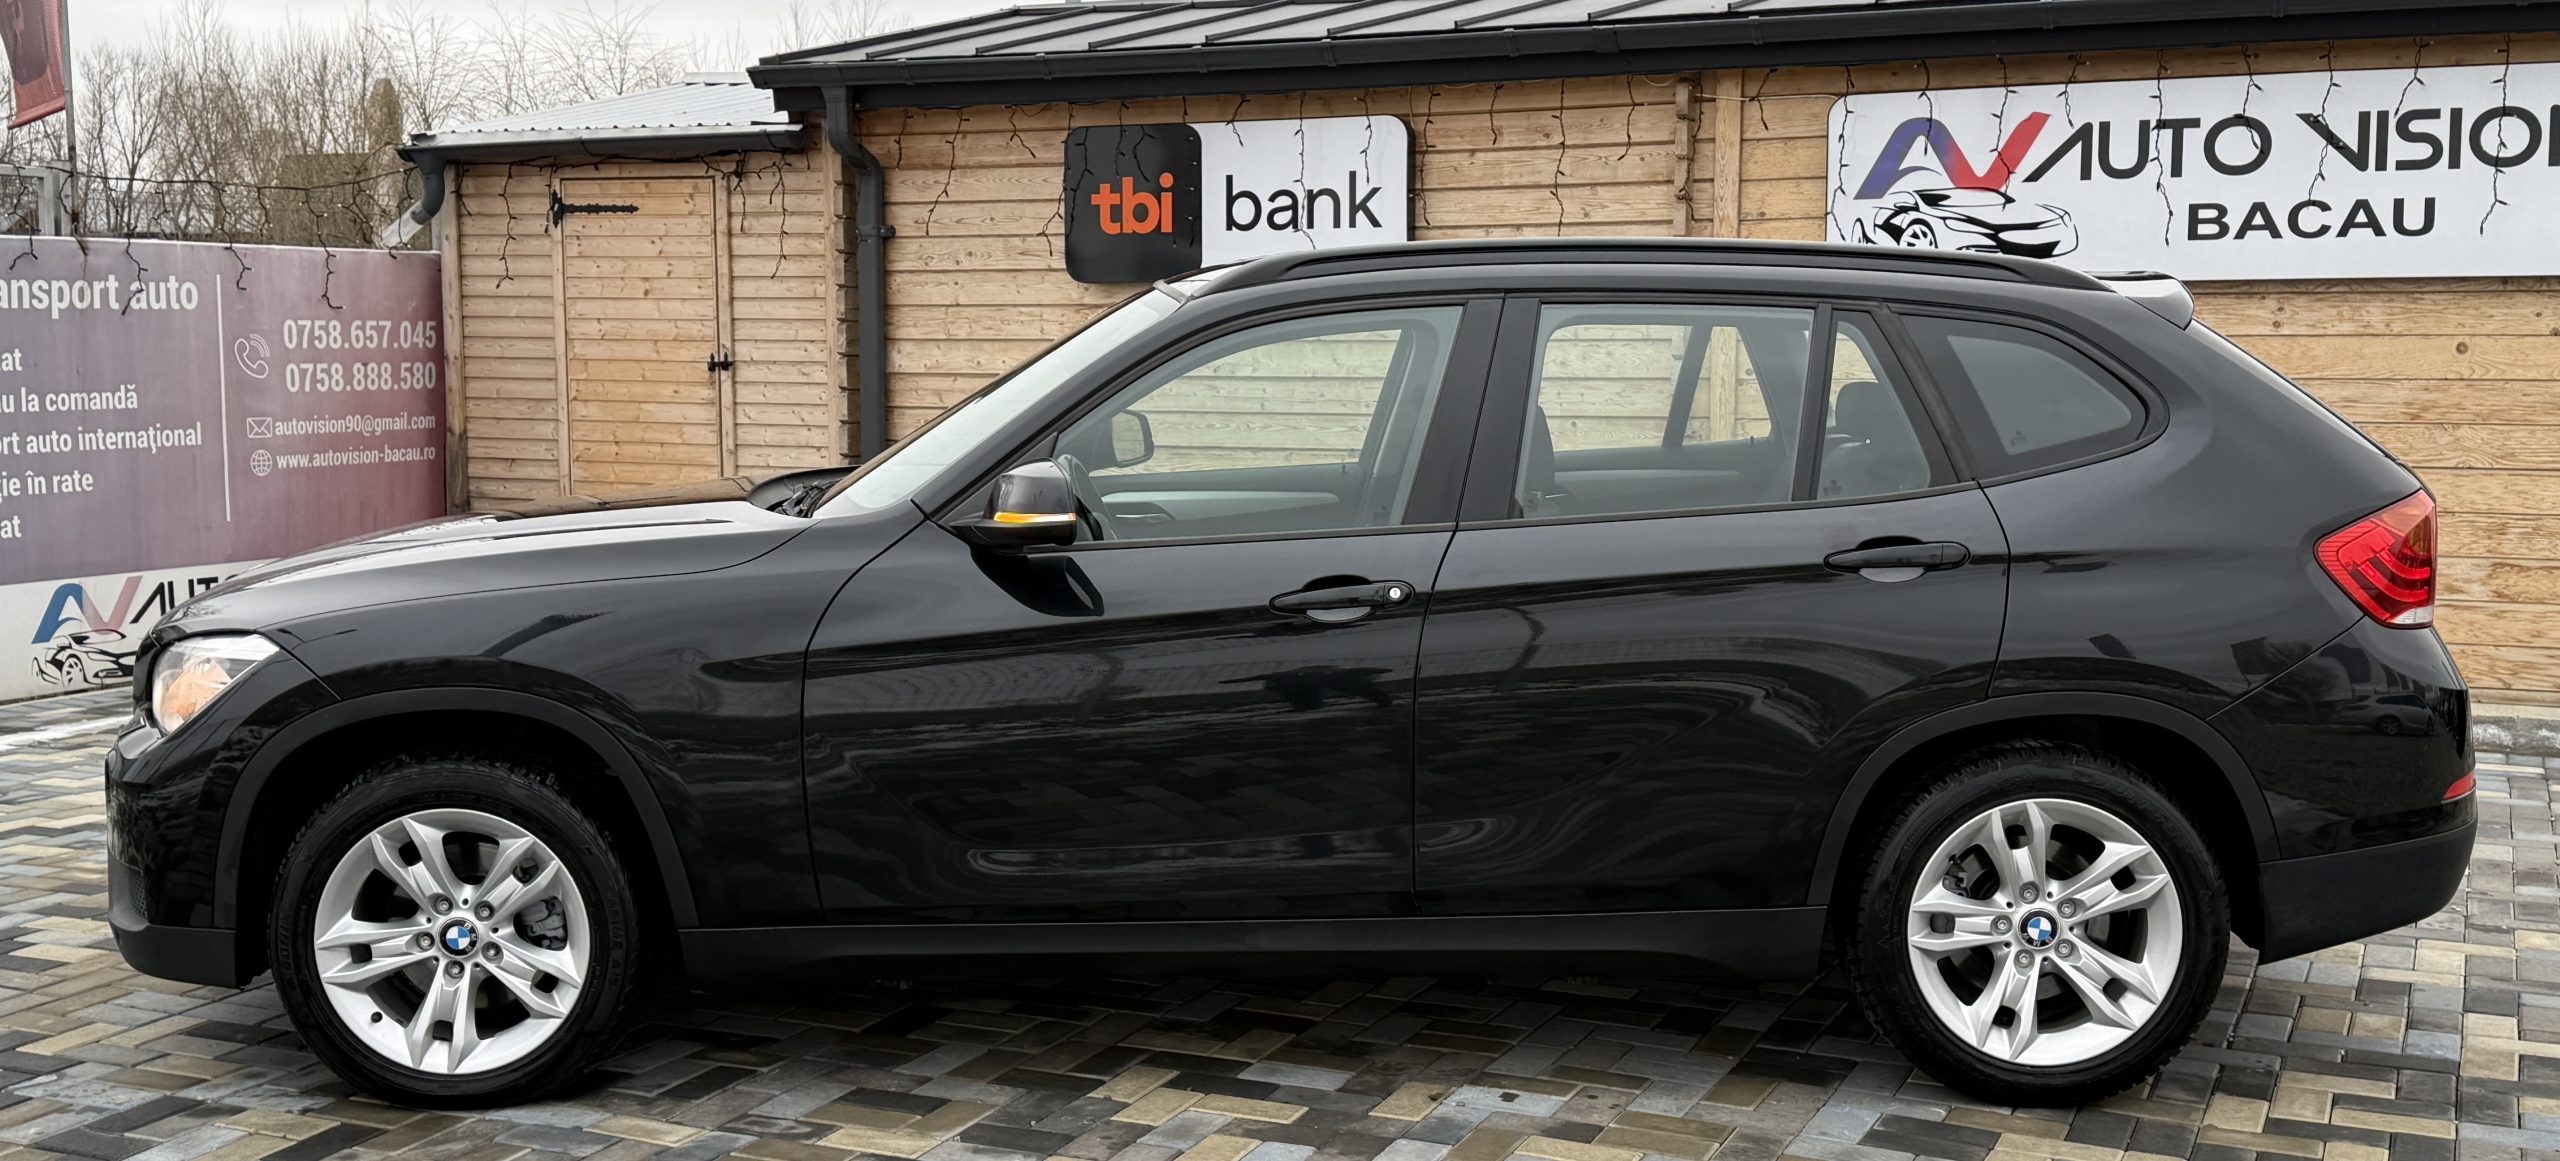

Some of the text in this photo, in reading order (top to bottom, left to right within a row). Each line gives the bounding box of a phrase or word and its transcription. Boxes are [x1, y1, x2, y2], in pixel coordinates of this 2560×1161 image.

[2022, 104, 2560, 183] AUTO VISIO
[1091, 170, 1383, 235] tbi bank
[2187, 197, 2436, 241] BACAU
[129, 275, 199, 310] auto
[283, 319, 437, 350] 0758.657.045
[285, 361, 437, 393] 0758.888.580
[21, 386, 40, 412] la
[45, 384, 139, 411] comandă
[274, 412, 436, 437] autovision90@gmail.com
[26, 430, 72, 454] auto
[276, 444, 436, 469] www.autovision-bacau.ro
[25, 470, 47, 495] în
[52, 470, 94, 494] rate
